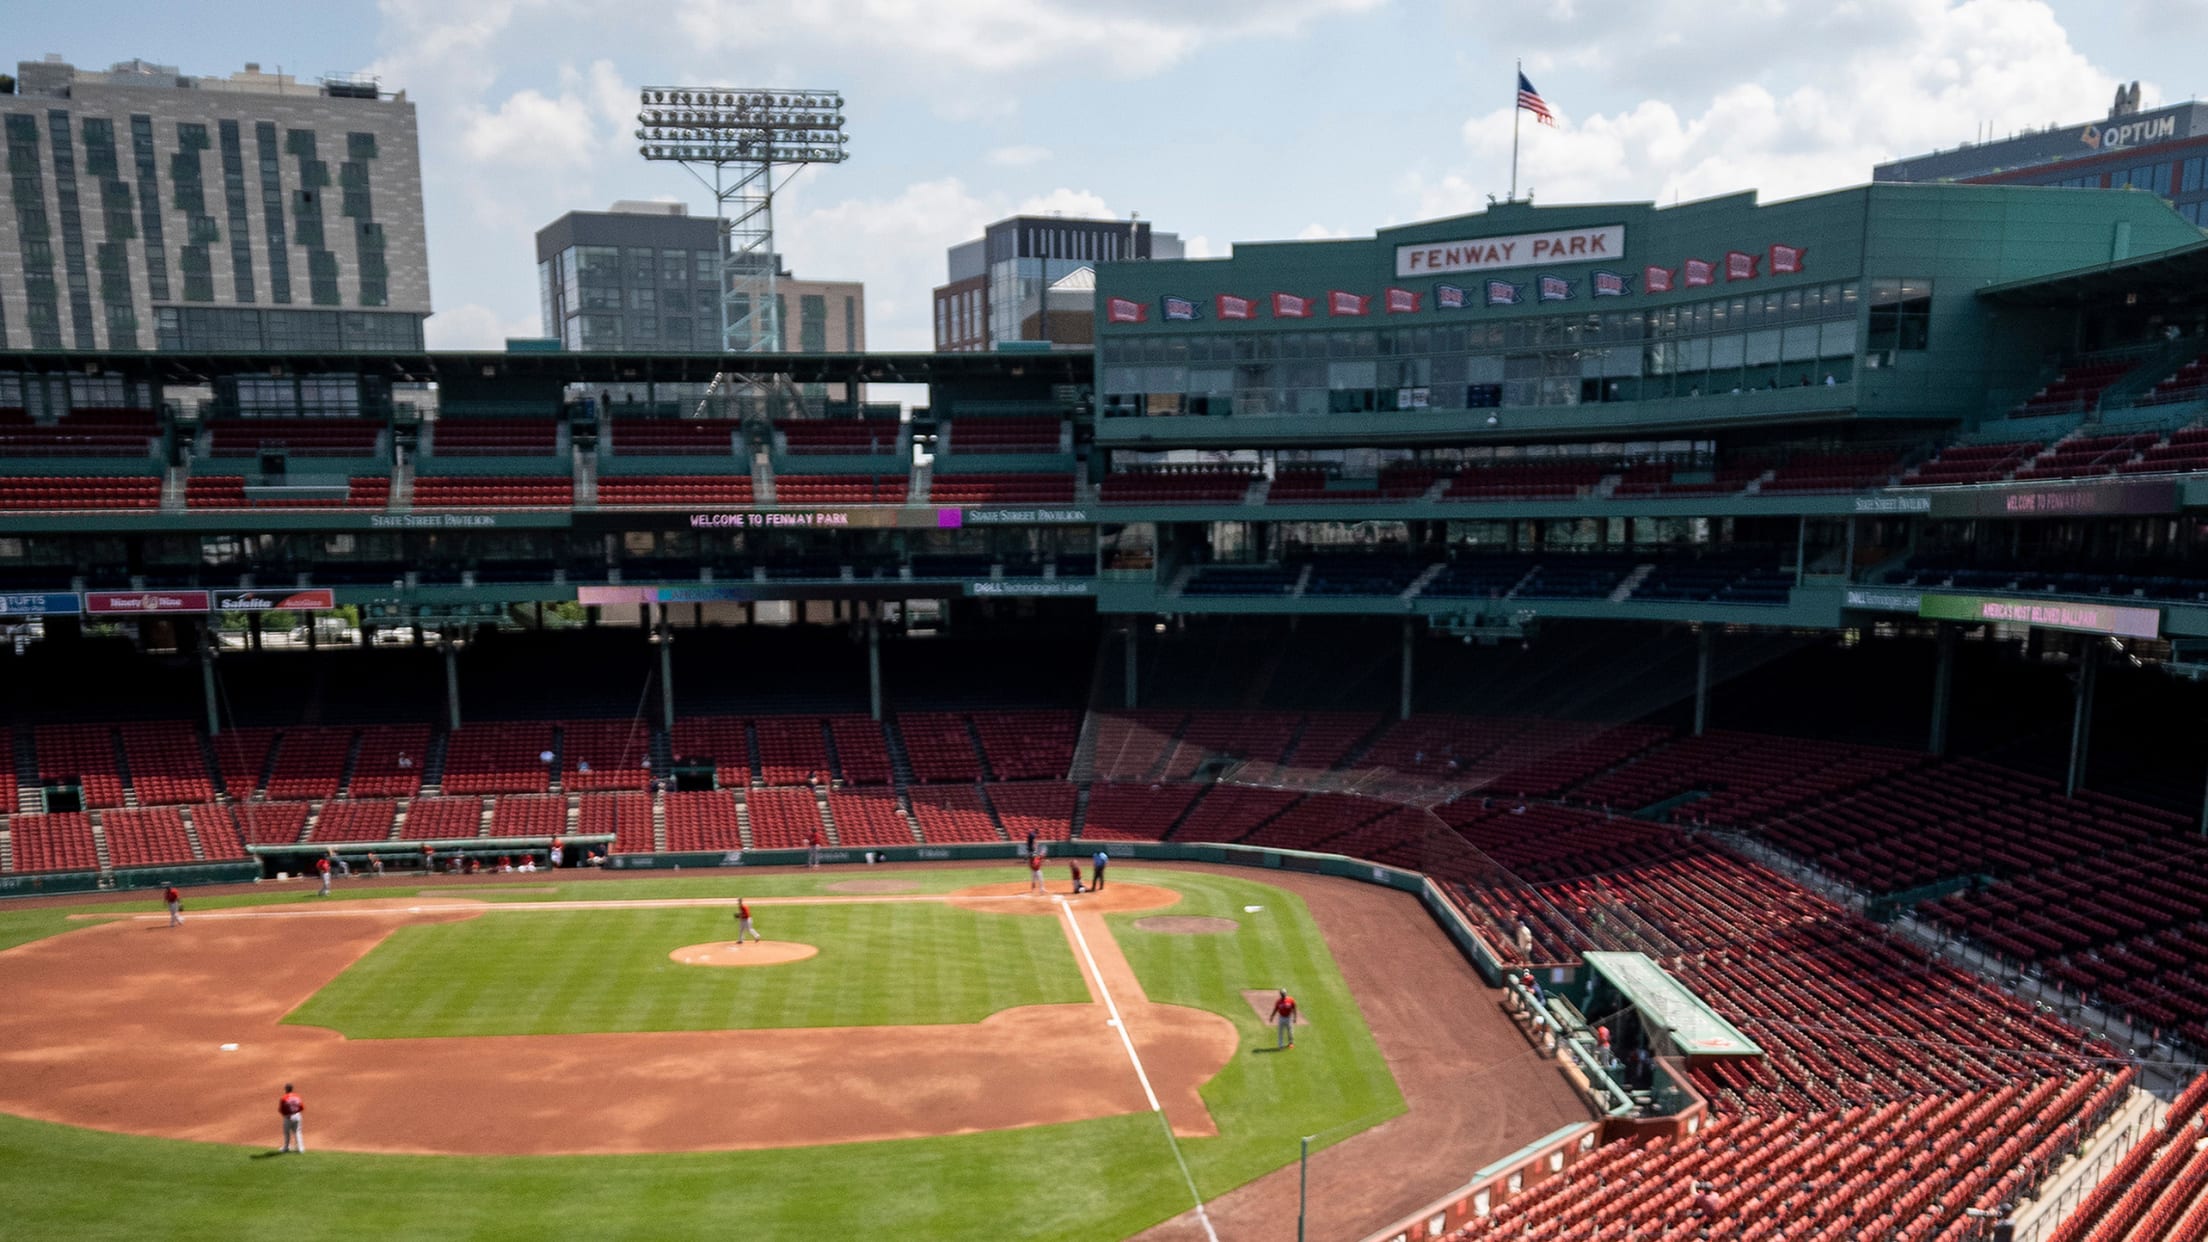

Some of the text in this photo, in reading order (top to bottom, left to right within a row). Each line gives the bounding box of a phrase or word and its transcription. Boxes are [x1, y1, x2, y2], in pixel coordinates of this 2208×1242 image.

[2103, 115, 2175, 147] OPTUM
[1409, 233, 1607, 270] FENWAY PARK
[370, 514, 496, 527] STATE STREET PAVILION
[690, 512, 849, 527] WELCOME TO FENWAY PARK
[969, 509, 1087, 522] STATE STREET PAVILION
[973, 582, 1001, 593] DELL
[8, 596, 46, 605] TUFTS
[221, 598, 273, 608] Safelite
